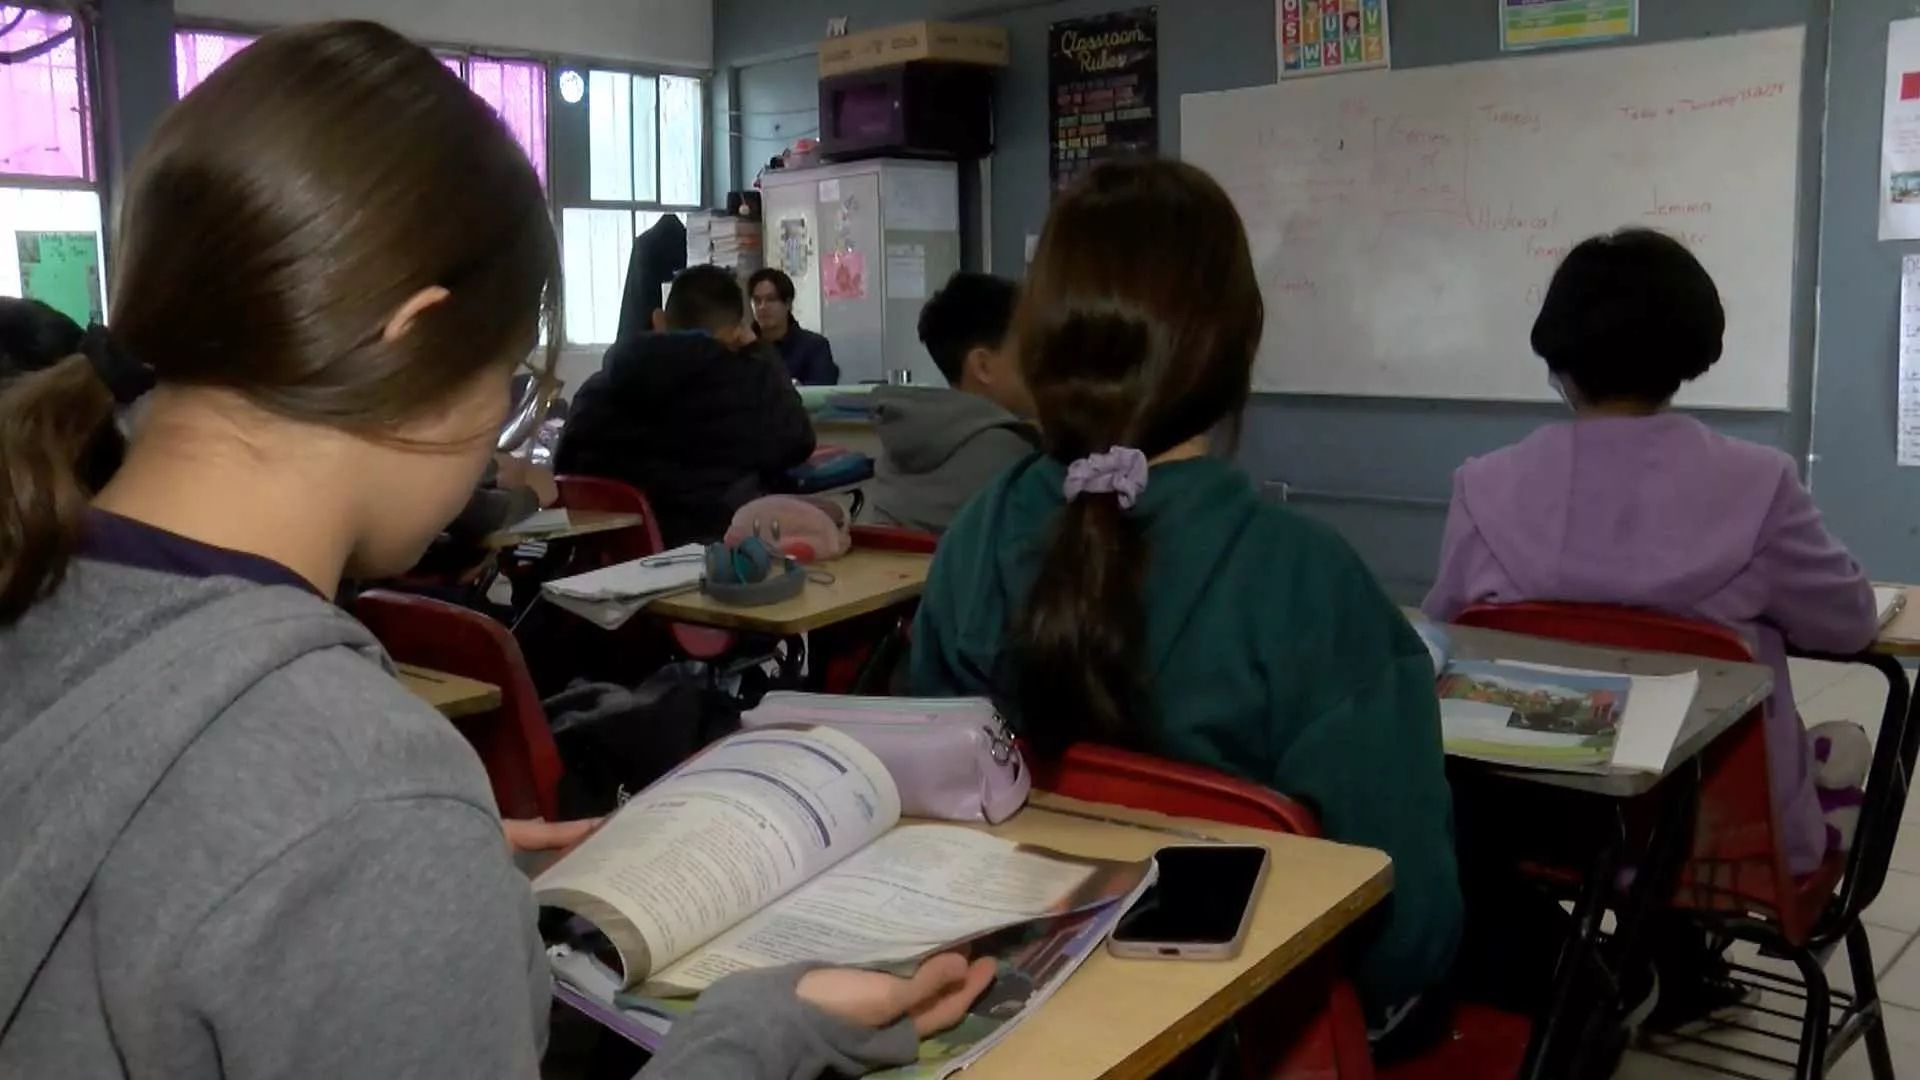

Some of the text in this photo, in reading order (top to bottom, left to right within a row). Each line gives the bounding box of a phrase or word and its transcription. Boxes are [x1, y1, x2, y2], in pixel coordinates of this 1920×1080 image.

[1286, 9, 1378, 37] S T U V
[1061, 28, 1148, 56] Classroom
[1304, 37, 1380, 59] W X Y Z
[1080, 49, 1127, 73] Rules
